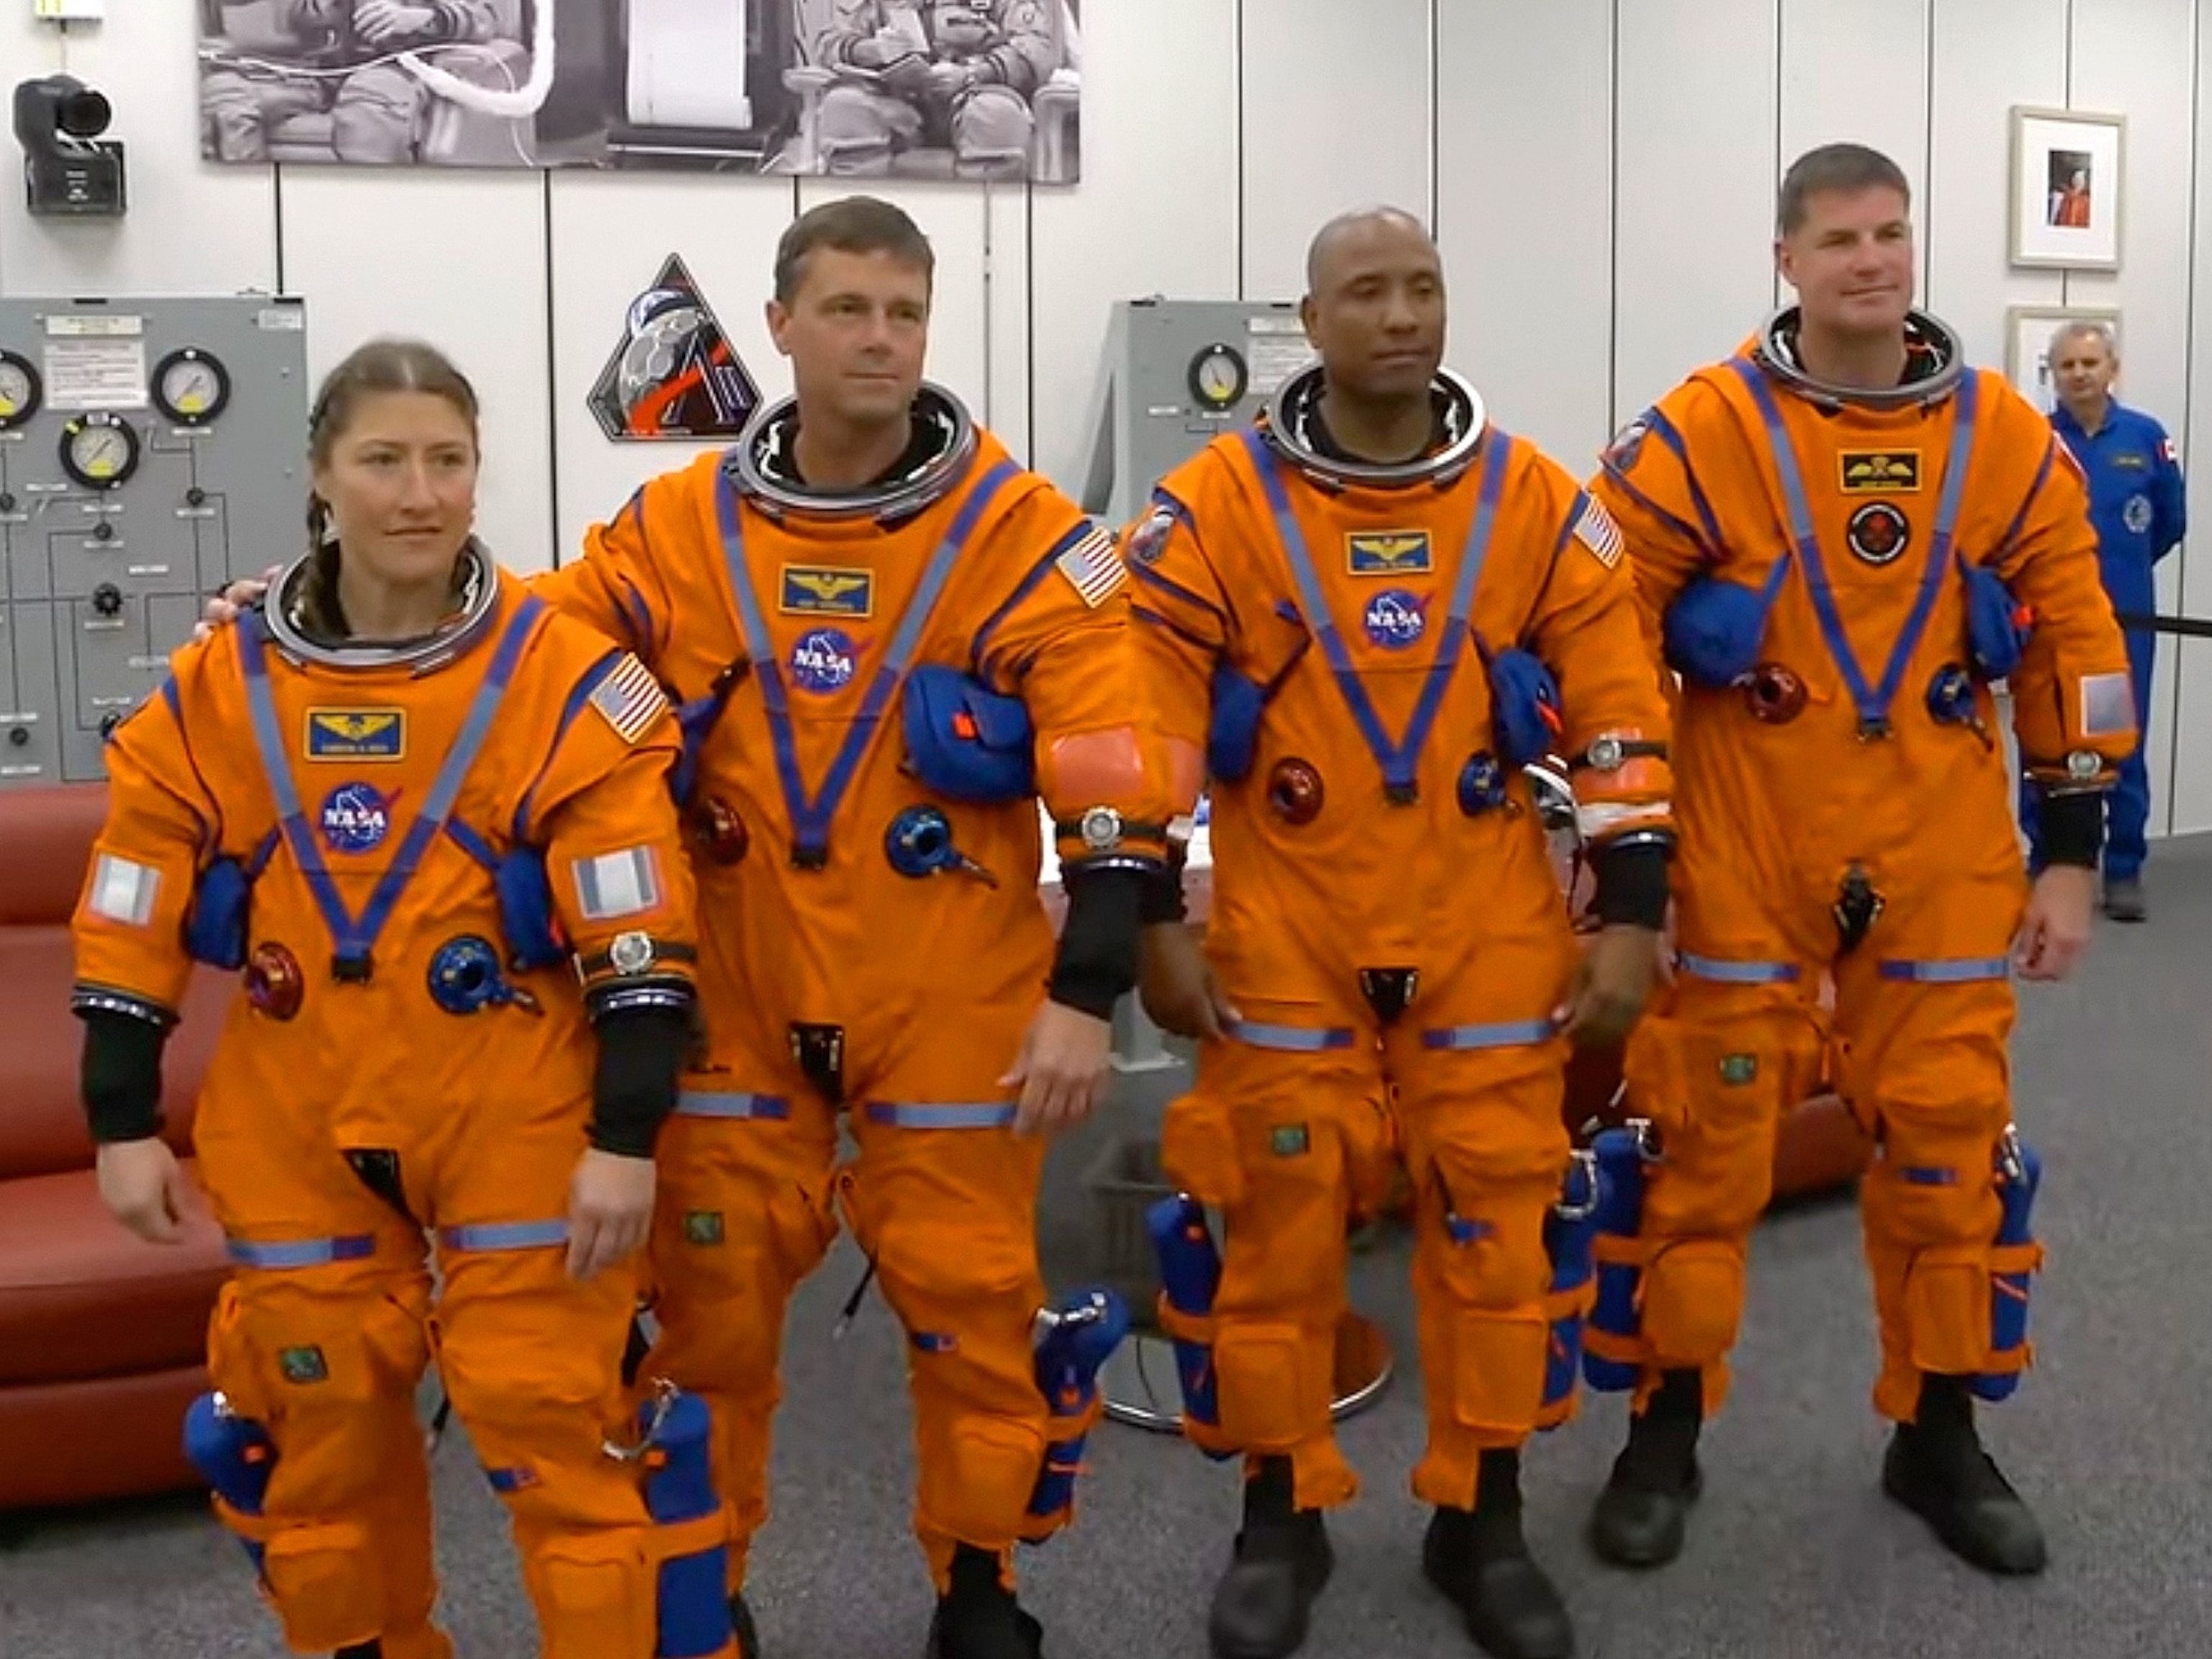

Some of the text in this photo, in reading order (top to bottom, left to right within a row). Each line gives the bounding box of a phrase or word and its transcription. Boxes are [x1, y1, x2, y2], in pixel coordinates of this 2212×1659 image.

[1367, 611, 1421, 626] NASA
[794, 649, 852, 672] NASA
[324, 809, 385, 827] NASA
